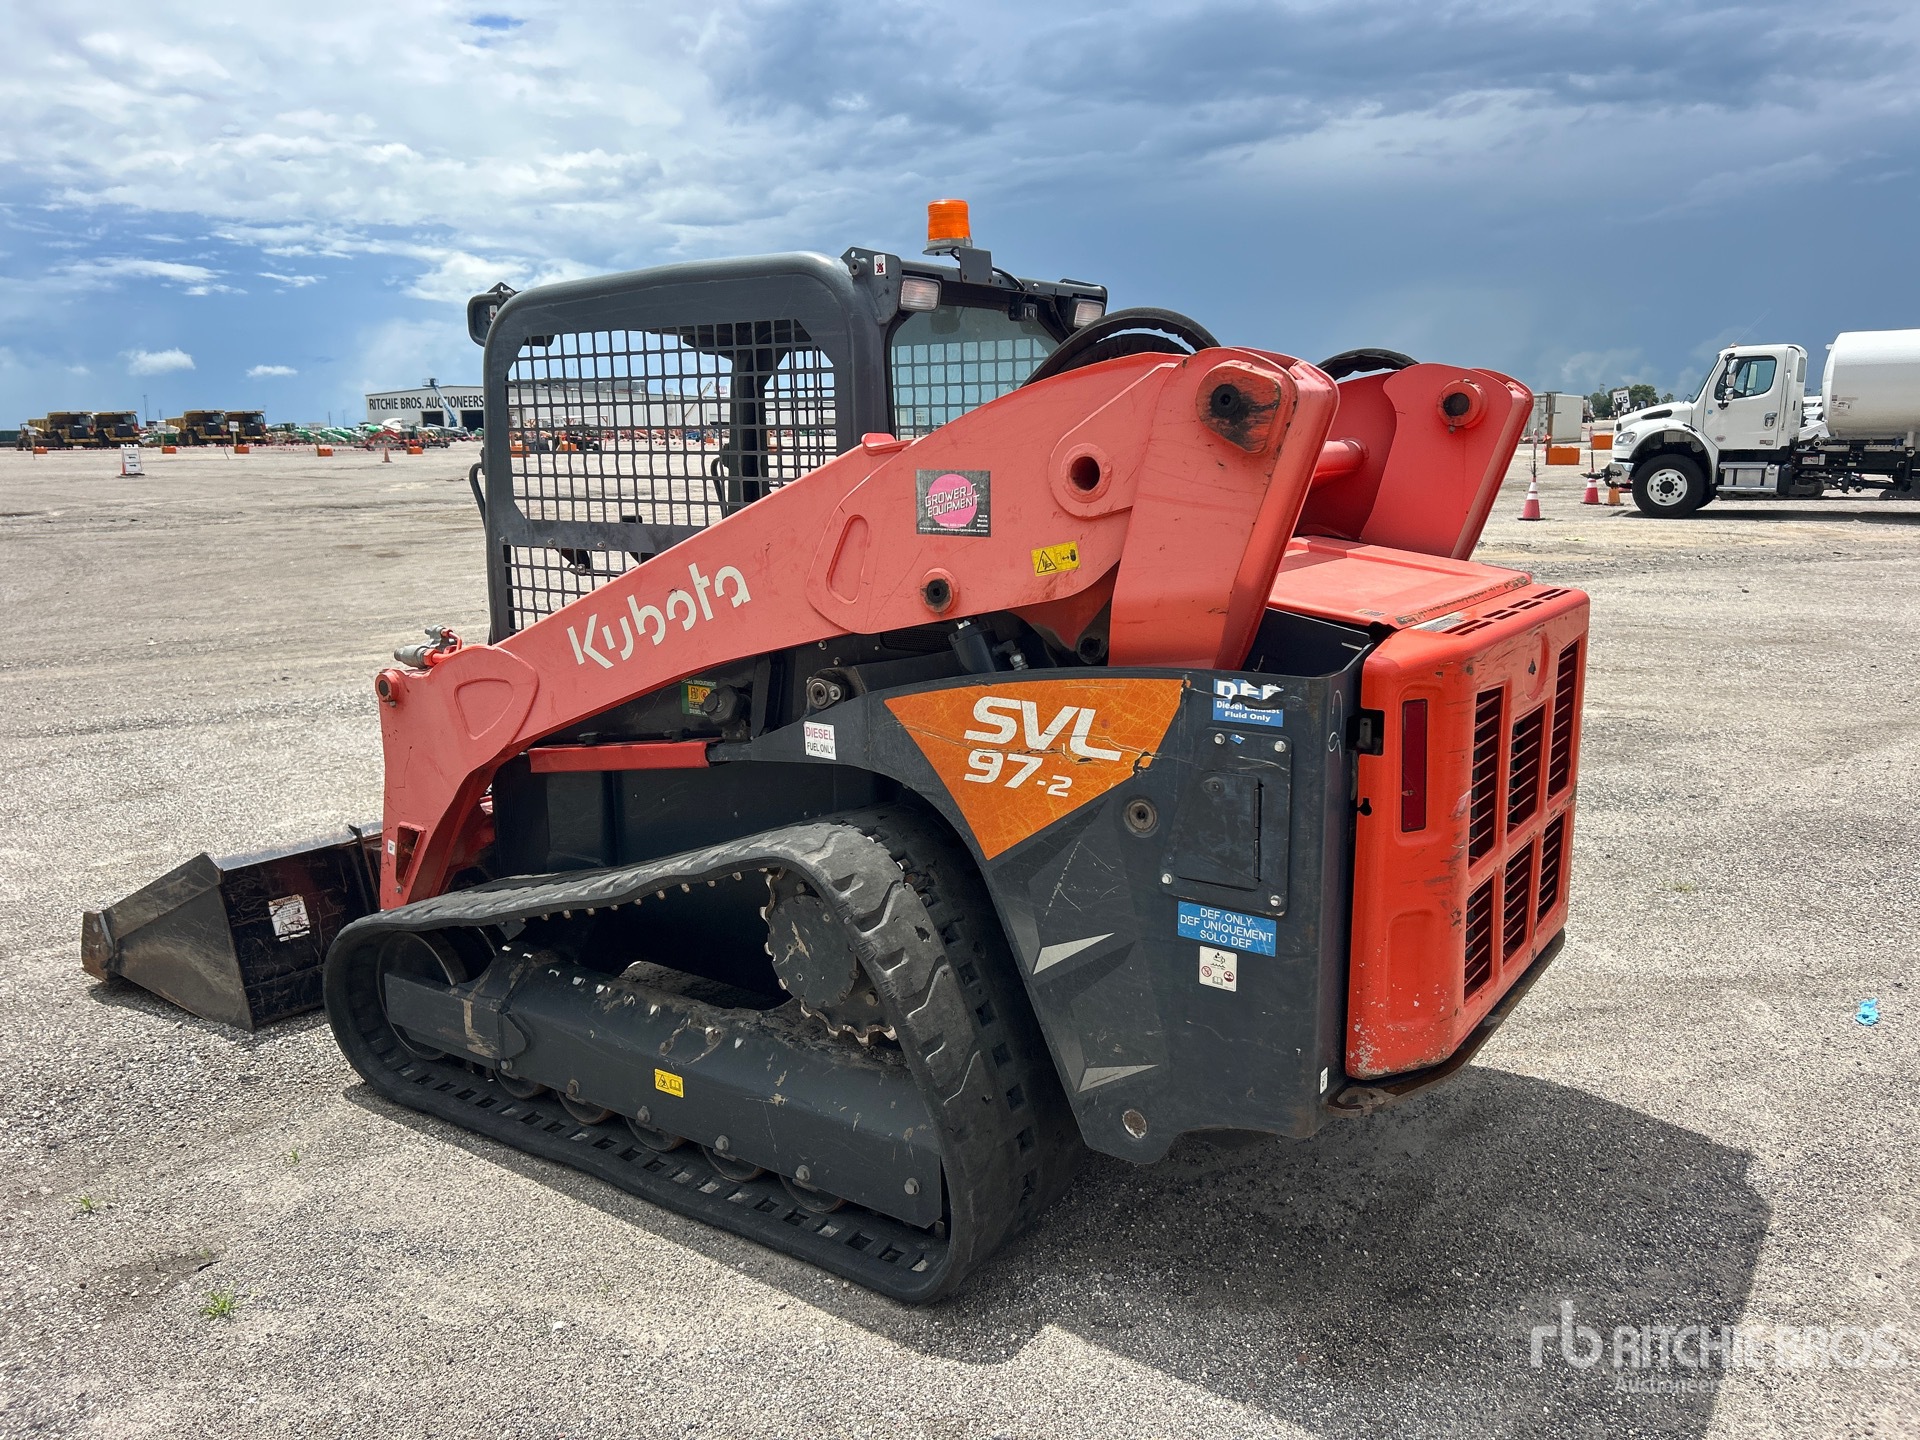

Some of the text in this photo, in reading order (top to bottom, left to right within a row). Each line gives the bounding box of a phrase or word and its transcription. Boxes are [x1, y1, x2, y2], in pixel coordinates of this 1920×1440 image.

[369, 398, 398, 410] RITCHIE
[400, 397, 424, 410] BROS.
[925, 483, 977, 507] GROWERS
[927, 494, 980, 517] EQUIPMENT
[567, 562, 752, 669] Kubota
[1216, 701, 1243, 710] Diesel
[1224, 711, 1271, 723] Fluid Only
[805, 726, 834, 741] DIESEL
[963, 696, 1122, 761] SVL
[807, 741, 834, 754] FUEL ONLY
[963, 748, 1073, 798] 97-2
[1200, 907, 1253, 927] DEF ONLY
[1180, 914, 1274, 943] DEF UNIQUEMENT
[1199, 930, 1252, 949] SOLO DEF
